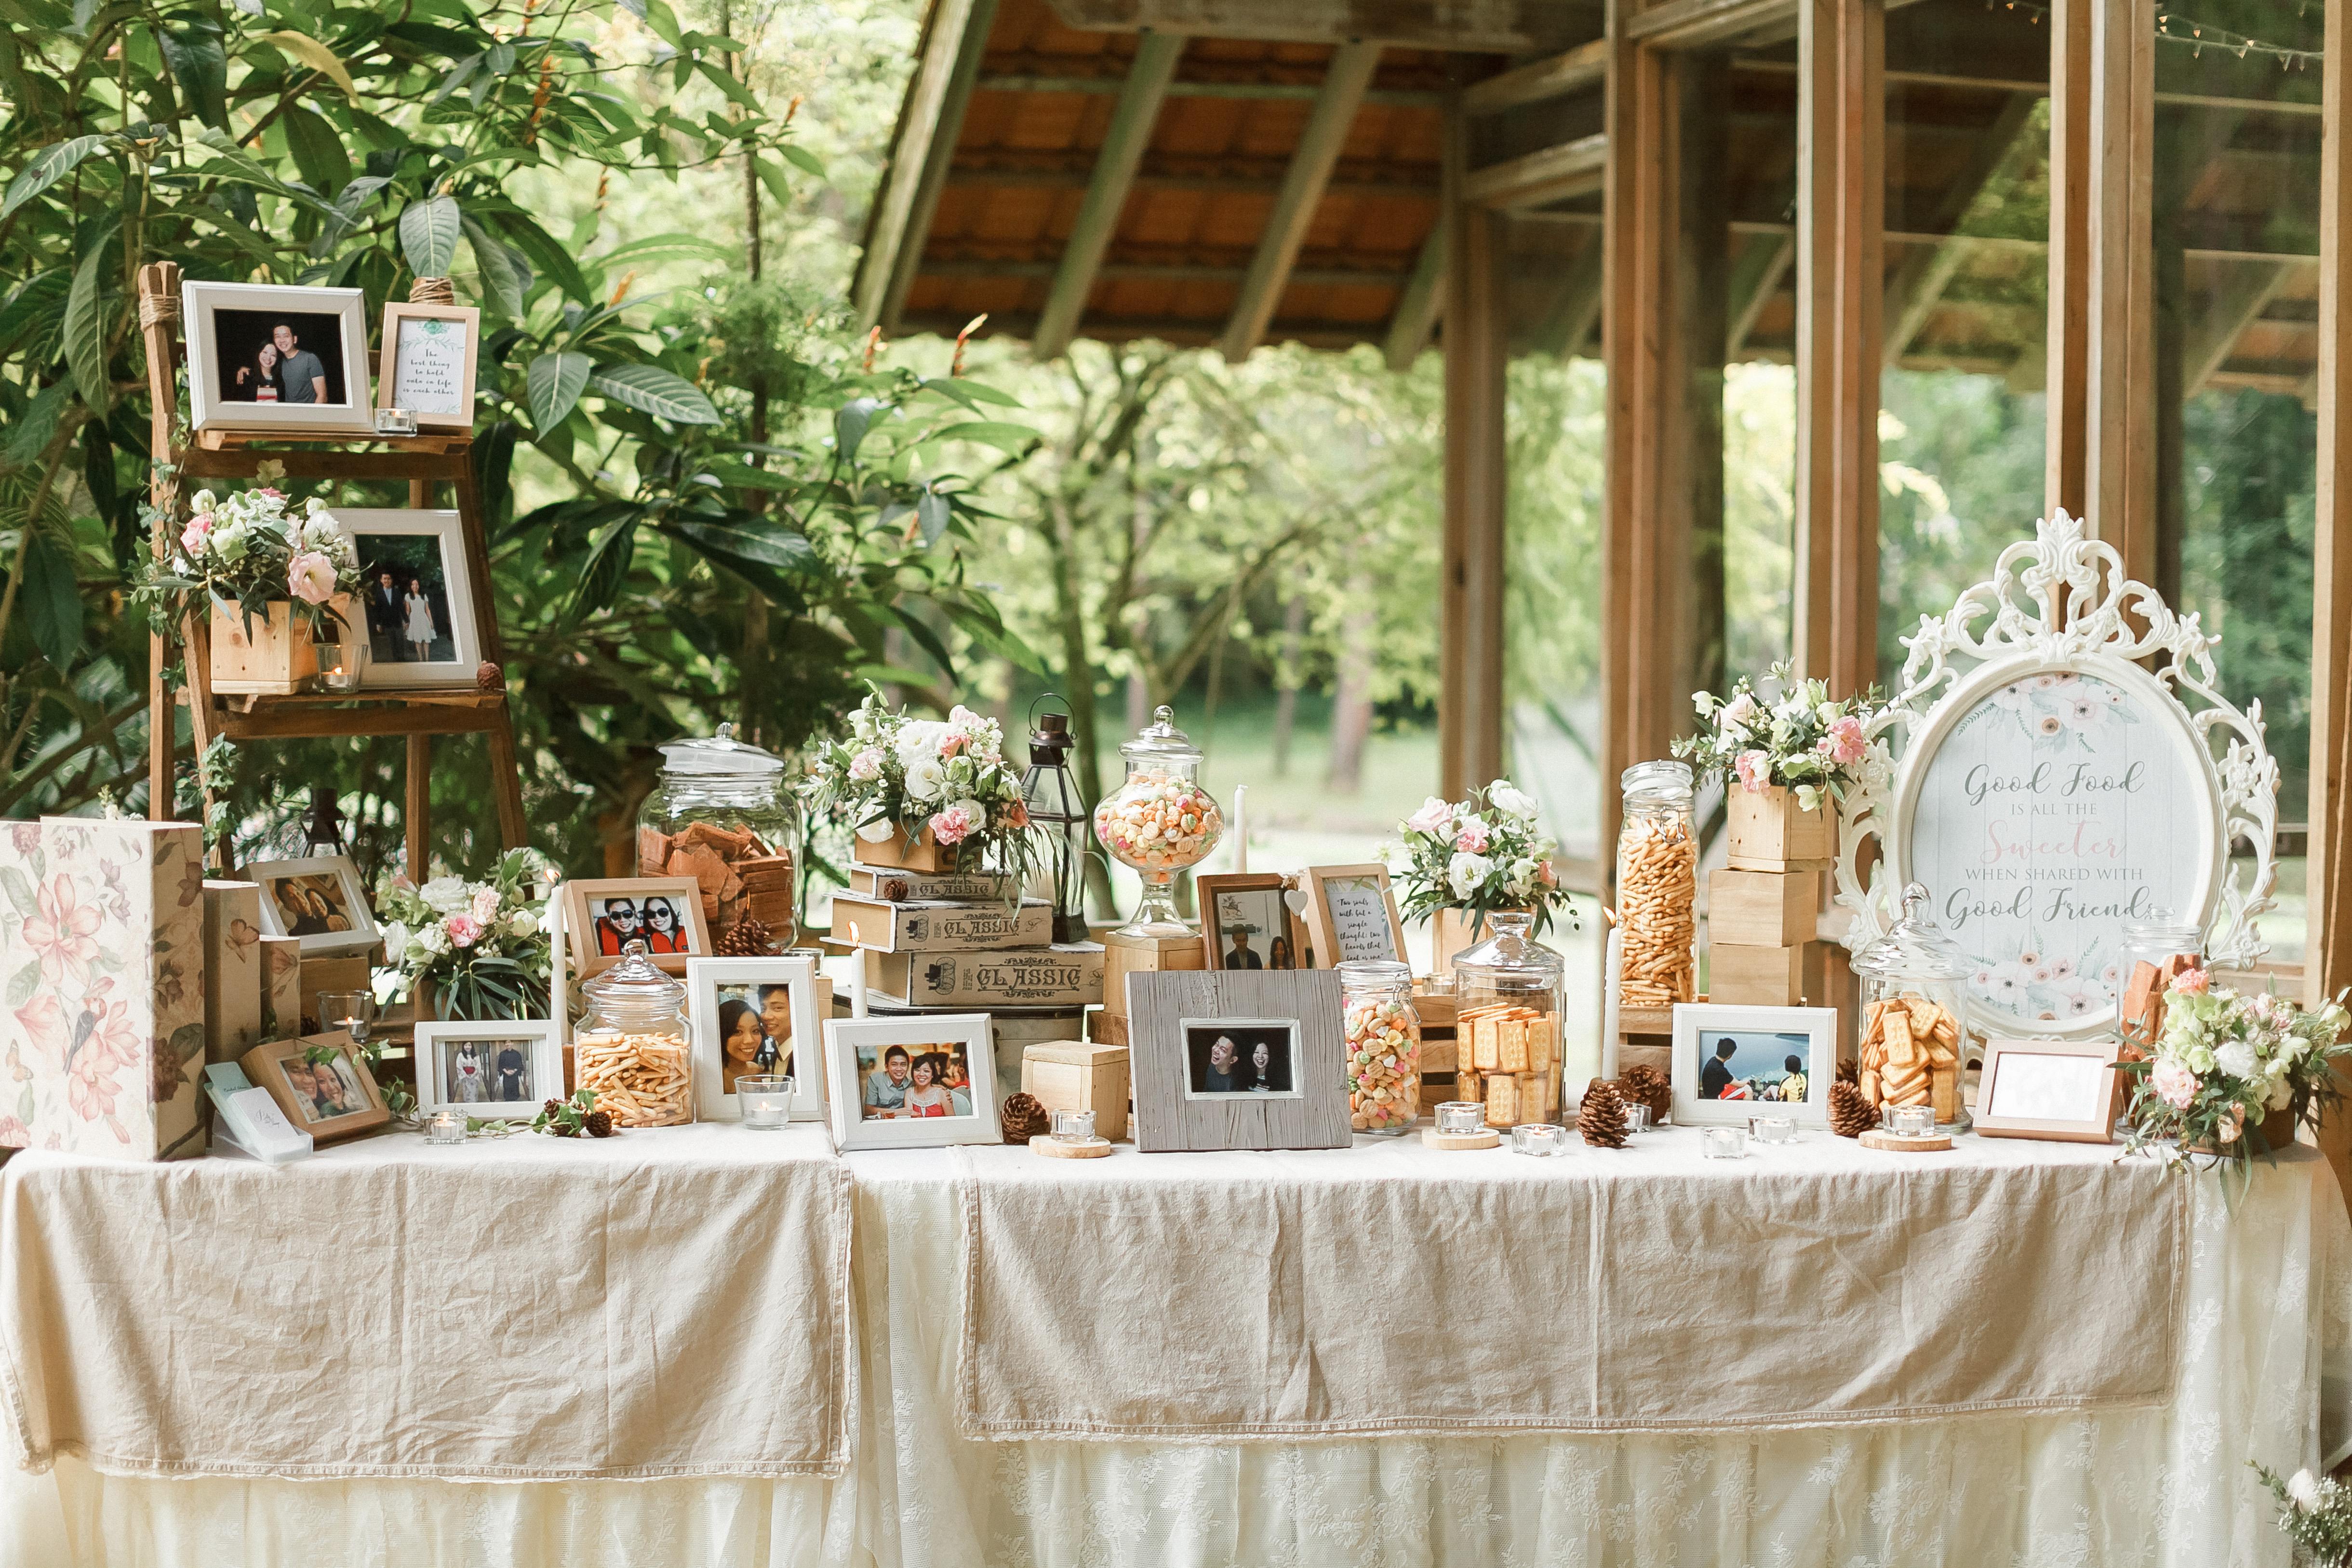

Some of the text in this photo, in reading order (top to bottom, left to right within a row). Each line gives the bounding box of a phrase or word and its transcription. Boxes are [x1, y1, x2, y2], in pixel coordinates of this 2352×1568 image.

[426, 348, 438, 357] The
[438, 379, 451, 388] life
[1964, 761, 2145, 805] Good Food
[2011, 803, 2097, 815] IS ALL THE
[1980, 820, 2126, 864] Sweeter
[1965, 868, 2143, 880] WHEN SHARED WITH
[1353, 898, 1368, 906] souls
[1945, 886, 2033, 930] Good
[1348, 920, 1367, 930] single
[976, 968, 1082, 990] CLASSIC
